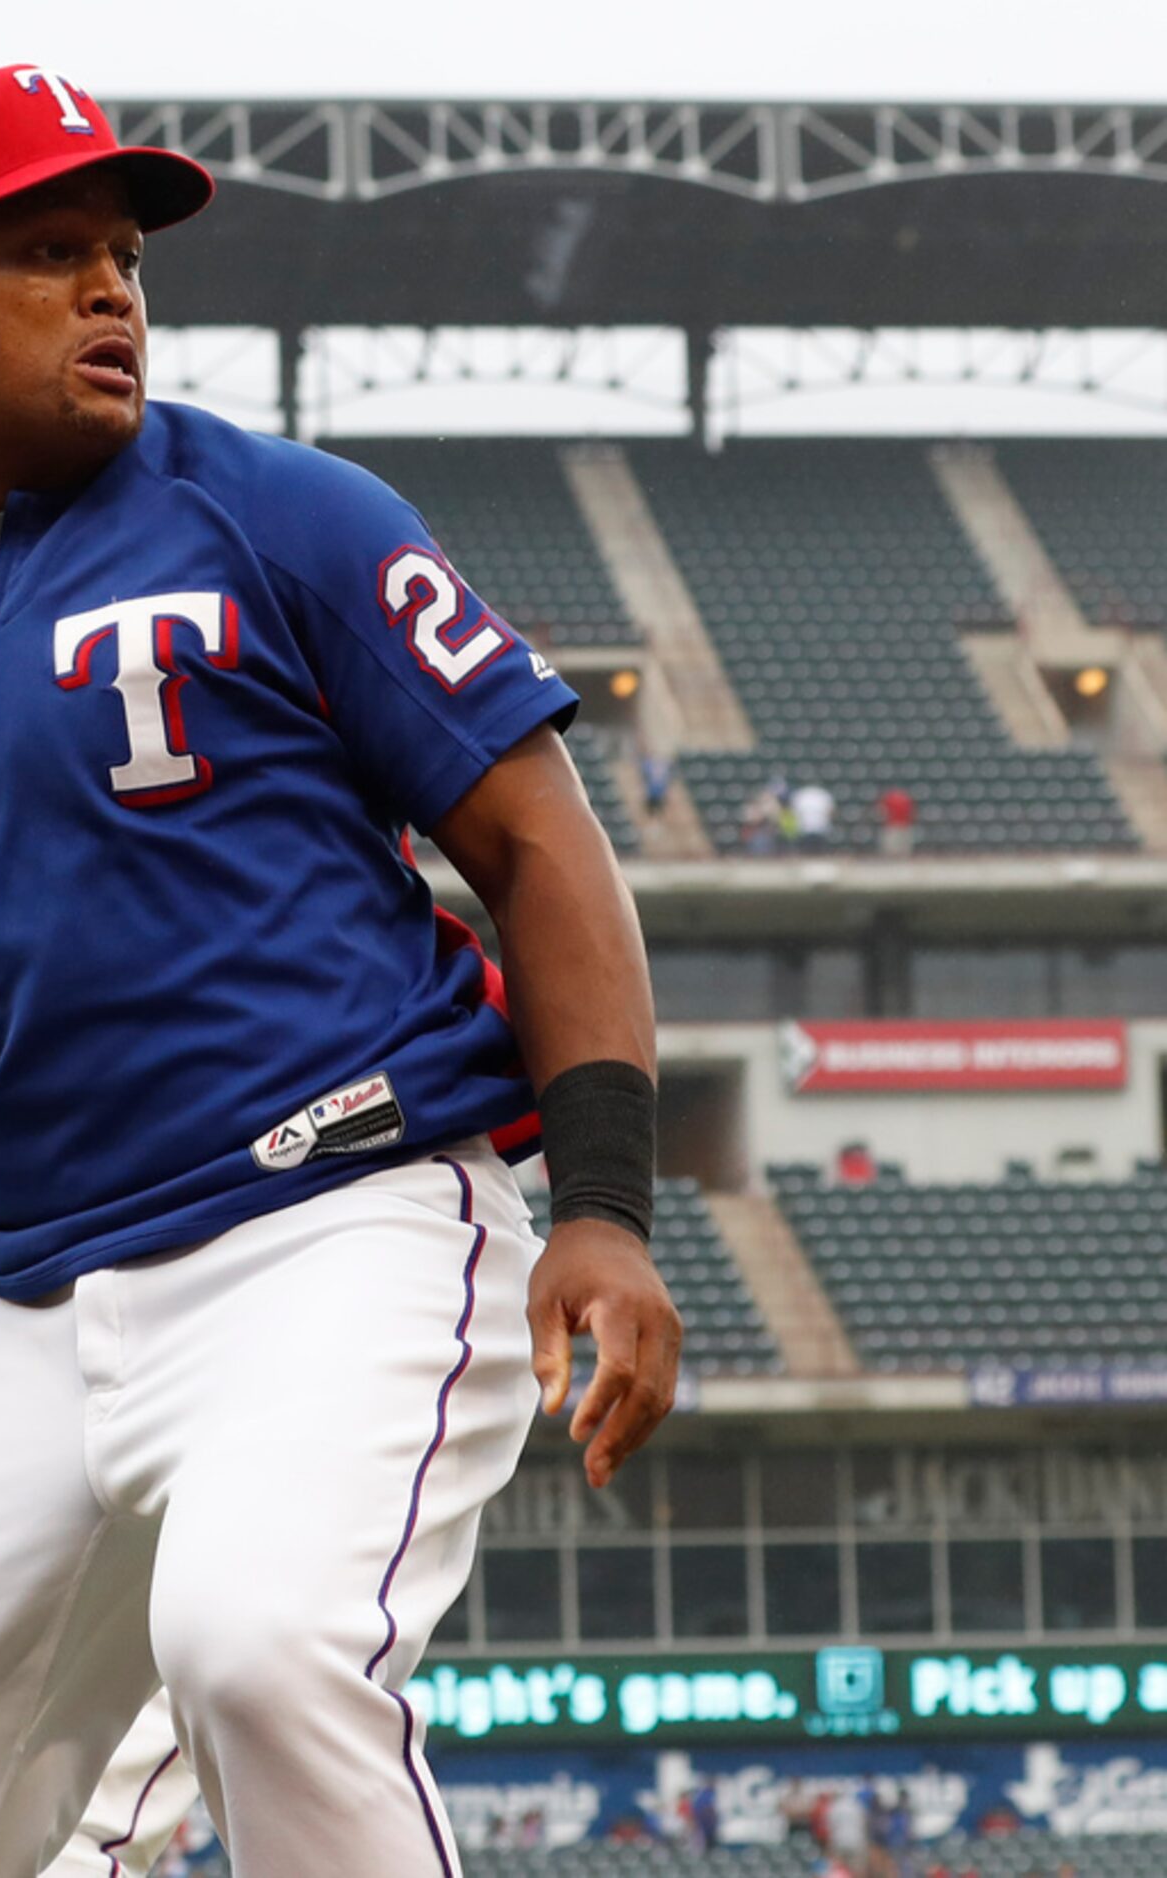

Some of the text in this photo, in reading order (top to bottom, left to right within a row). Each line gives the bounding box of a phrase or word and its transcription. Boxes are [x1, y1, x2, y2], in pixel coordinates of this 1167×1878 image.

[13, 67, 95, 136] T
[377, 543, 517, 697] 2
[53, 591, 239, 809] T
[618, 1671, 797, 1734] game.
[910, 1653, 1038, 1717] Pick
[1049, 1663, 1127, 1725] up
